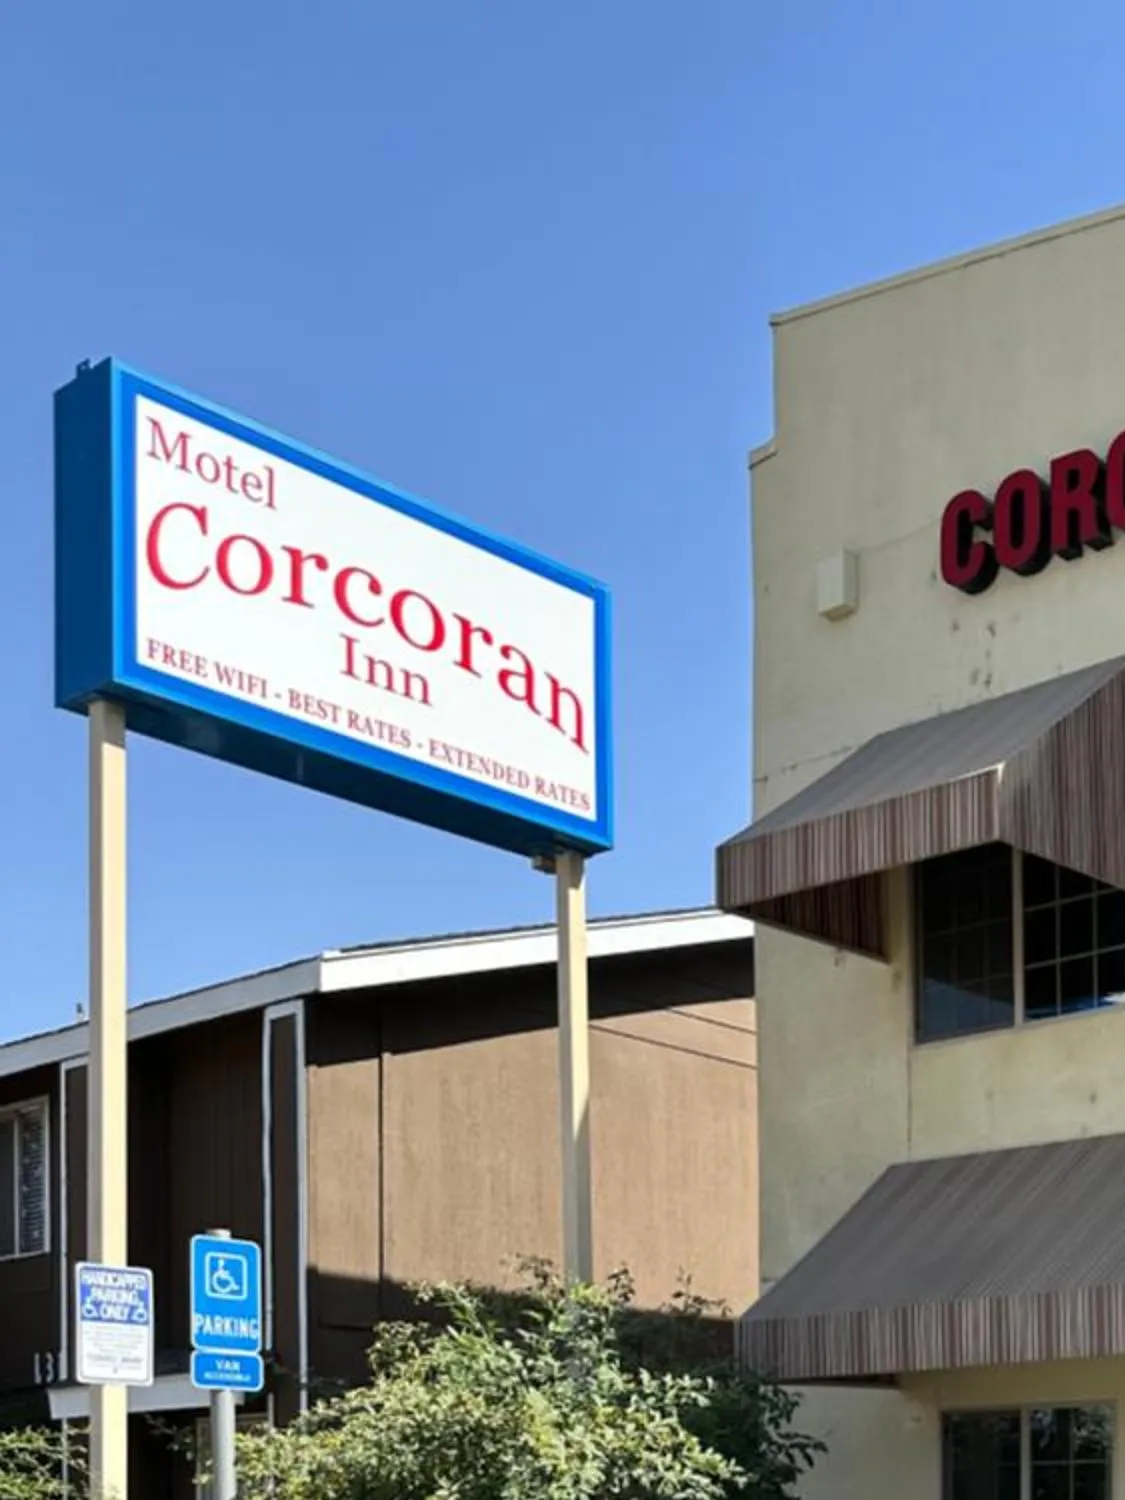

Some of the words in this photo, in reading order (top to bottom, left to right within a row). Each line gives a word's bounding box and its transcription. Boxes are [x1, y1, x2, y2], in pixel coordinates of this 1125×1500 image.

[147, 416, 277, 509] Motel
[146, 502, 590, 754] Corcoran
[340, 633, 432, 706] Inn
[147, 638, 208, 679] FREE
[214, 661, 268, 699] WIFI
[288, 688, 341, 723] BEST
[347, 709, 411, 749] RATES
[429, 740, 530, 789] EXTENDED
[535, 776, 590, 812] RATES
[194, 1313, 259, 1339] PARKING
[215, 1359, 240, 1371] VAN
